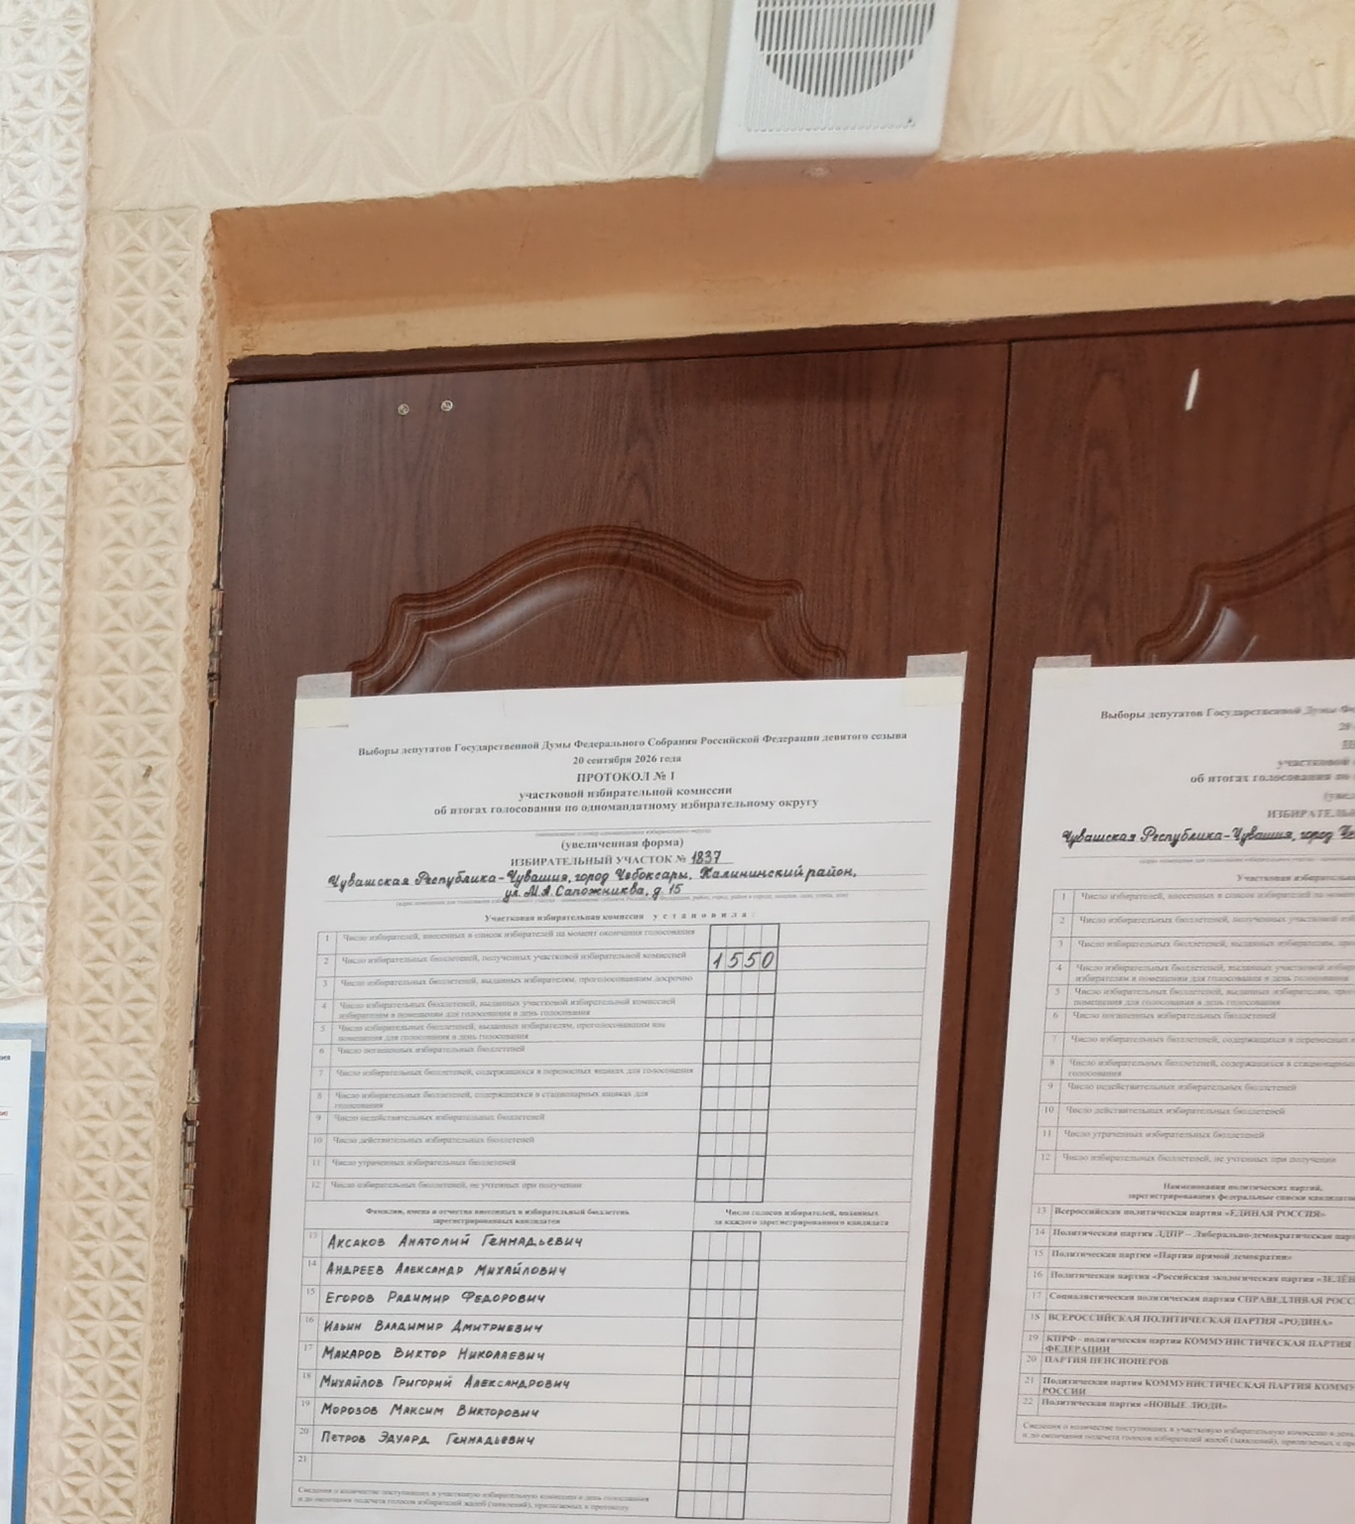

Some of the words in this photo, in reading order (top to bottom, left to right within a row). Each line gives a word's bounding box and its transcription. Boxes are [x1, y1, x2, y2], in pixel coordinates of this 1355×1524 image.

[1101, 710, 1145, 720] Выборы
[358, 746, 399, 757] Выборы
[401, 745, 452, 756] депутатов
[454, 741, 540, 754] Государственной
[542, 739, 571, 752] Думы
[574, 737, 645, 750] Федерального
[648, 736, 698, 748] Собрания
[701, 734, 760, 745] Российской
[762, 732, 820, 744] Федерации
[573, 755, 585, 765] 20
[586, 754, 633, 766] сентября
[635, 753, 657, 764] 2026
[576, 770, 650, 783] ПРОТОКОЛ
[518, 788, 584, 801] участковой
[587, 785, 673, 799] избирательной
[676, 784, 733, 796] комиссии
[434, 805, 447, 815] об
[450, 805, 487, 815] итогах
[491, 803, 561, 815] голосования
[565, 803, 579, 813] по
[581, 800, 677, 814] одномандатному
[680, 798, 775, 811] избирательному
[778, 798, 819, 809] округу
[561, 837, 639, 851] (увеличенная
[642, 836, 684, 849] форма)
[510, 854, 613, 867] ИЗБИРАТЕЛЬНЫЙ
[616, 853, 674, 866] УЧАСТОК
[691, 849, 722, 865] 1837
[669, 882, 683, 895] 15
[712, 950, 774, 969] 1550
